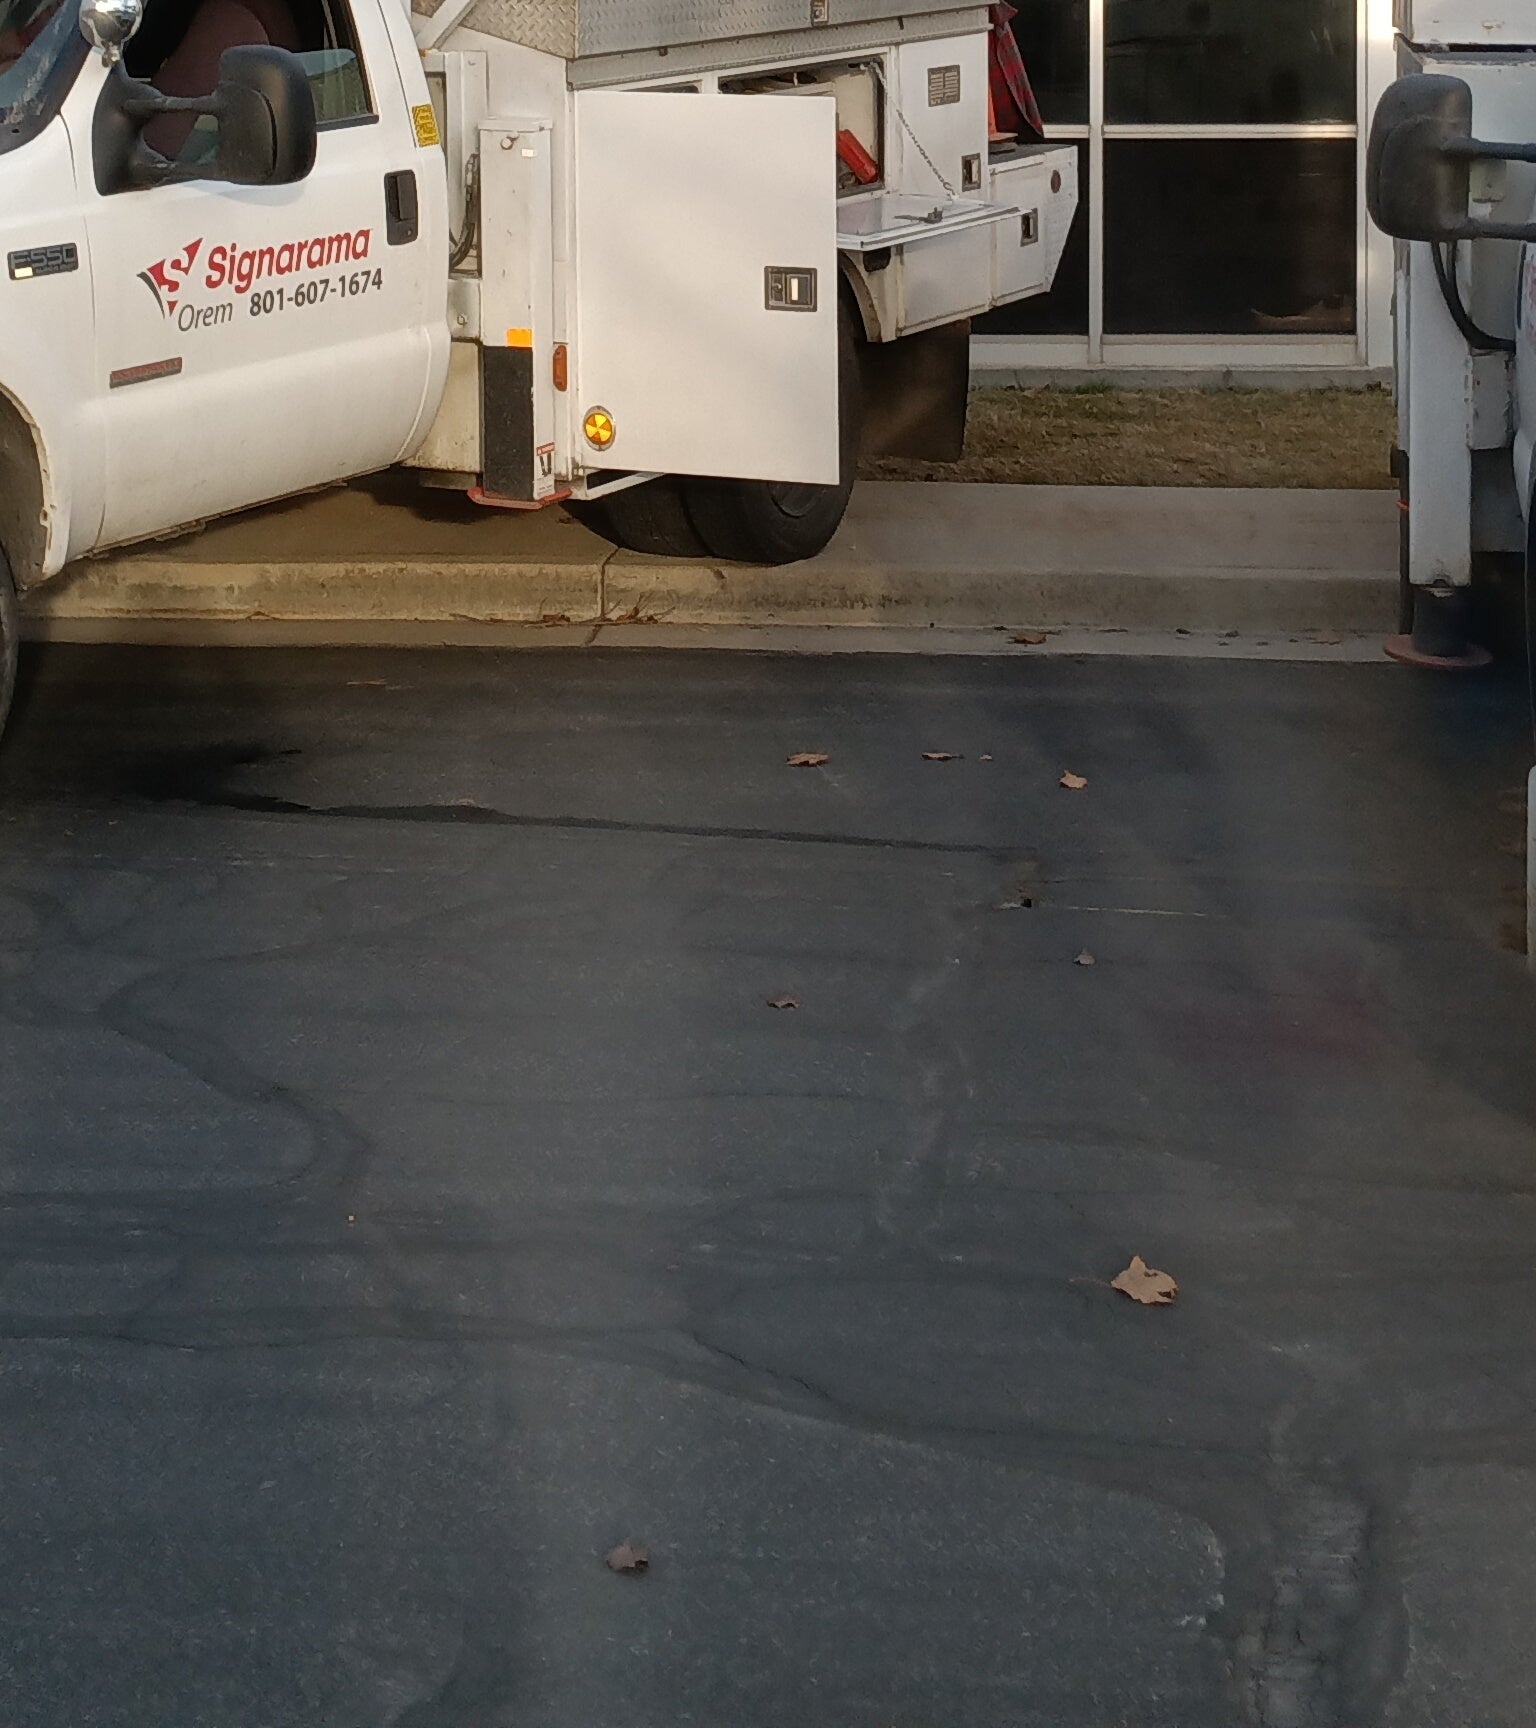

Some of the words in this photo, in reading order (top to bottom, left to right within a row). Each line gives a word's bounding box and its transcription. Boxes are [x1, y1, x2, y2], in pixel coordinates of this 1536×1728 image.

[205, 228, 371, 294] Signarama
[178, 302, 233, 332] Orem
[249, 268, 383, 317] 801-607-1674
